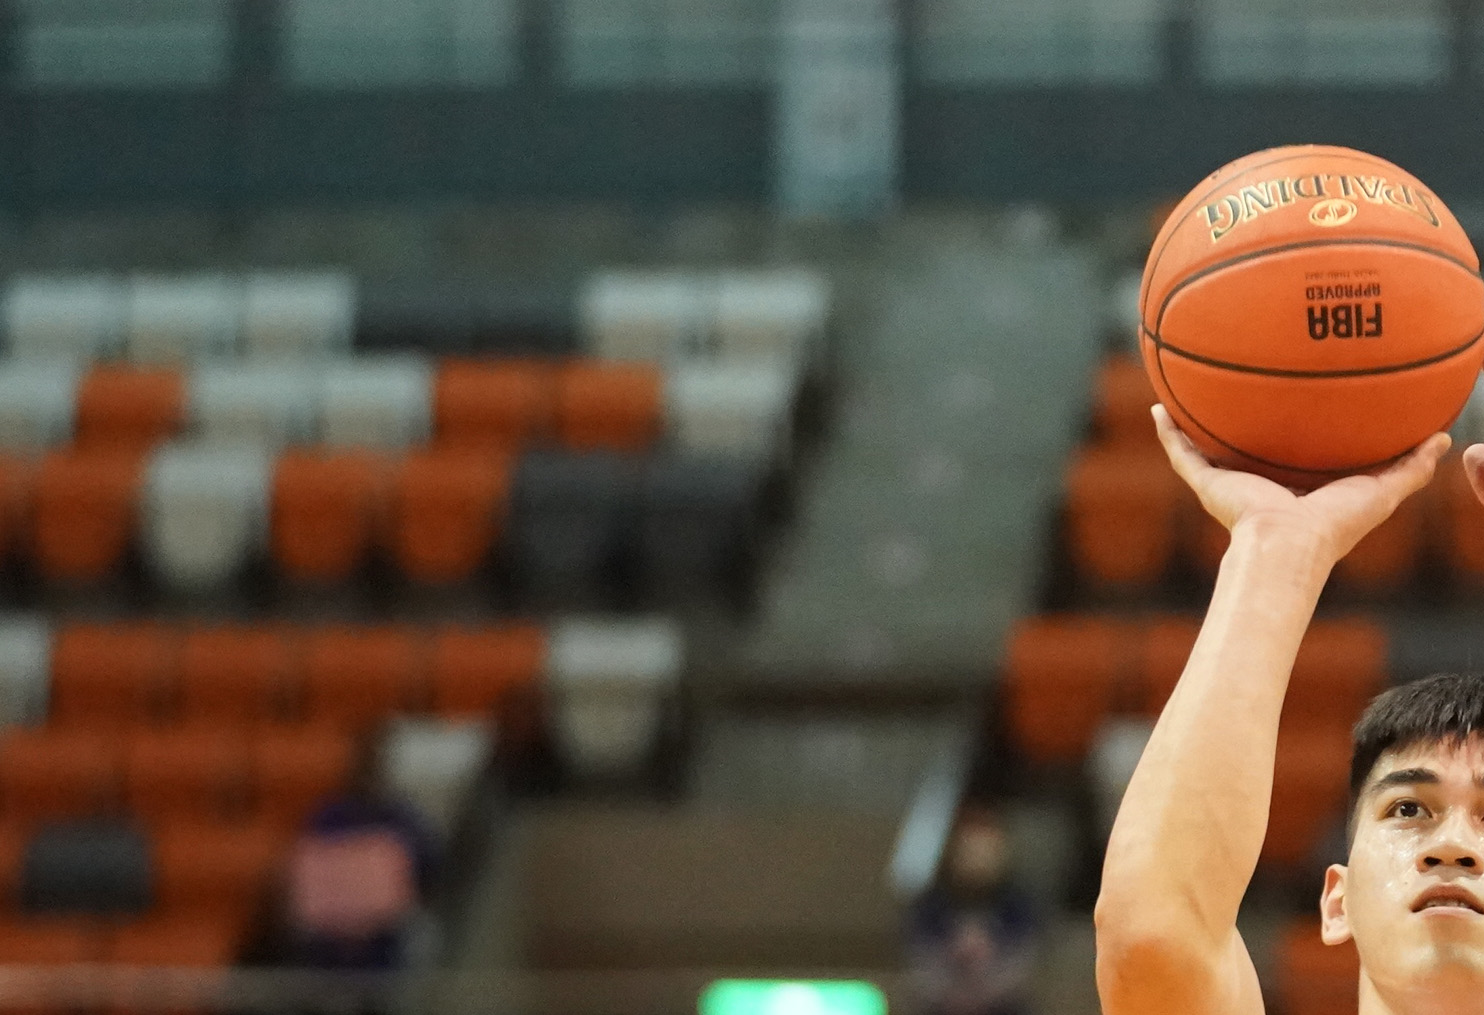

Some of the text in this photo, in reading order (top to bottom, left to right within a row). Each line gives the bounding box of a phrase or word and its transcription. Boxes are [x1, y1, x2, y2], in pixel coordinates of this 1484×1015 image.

[1197, 174, 1441, 243] SPALDING
[1306, 283, 1380, 300] APPROVED
[1307, 303, 1382, 340] FIBA
